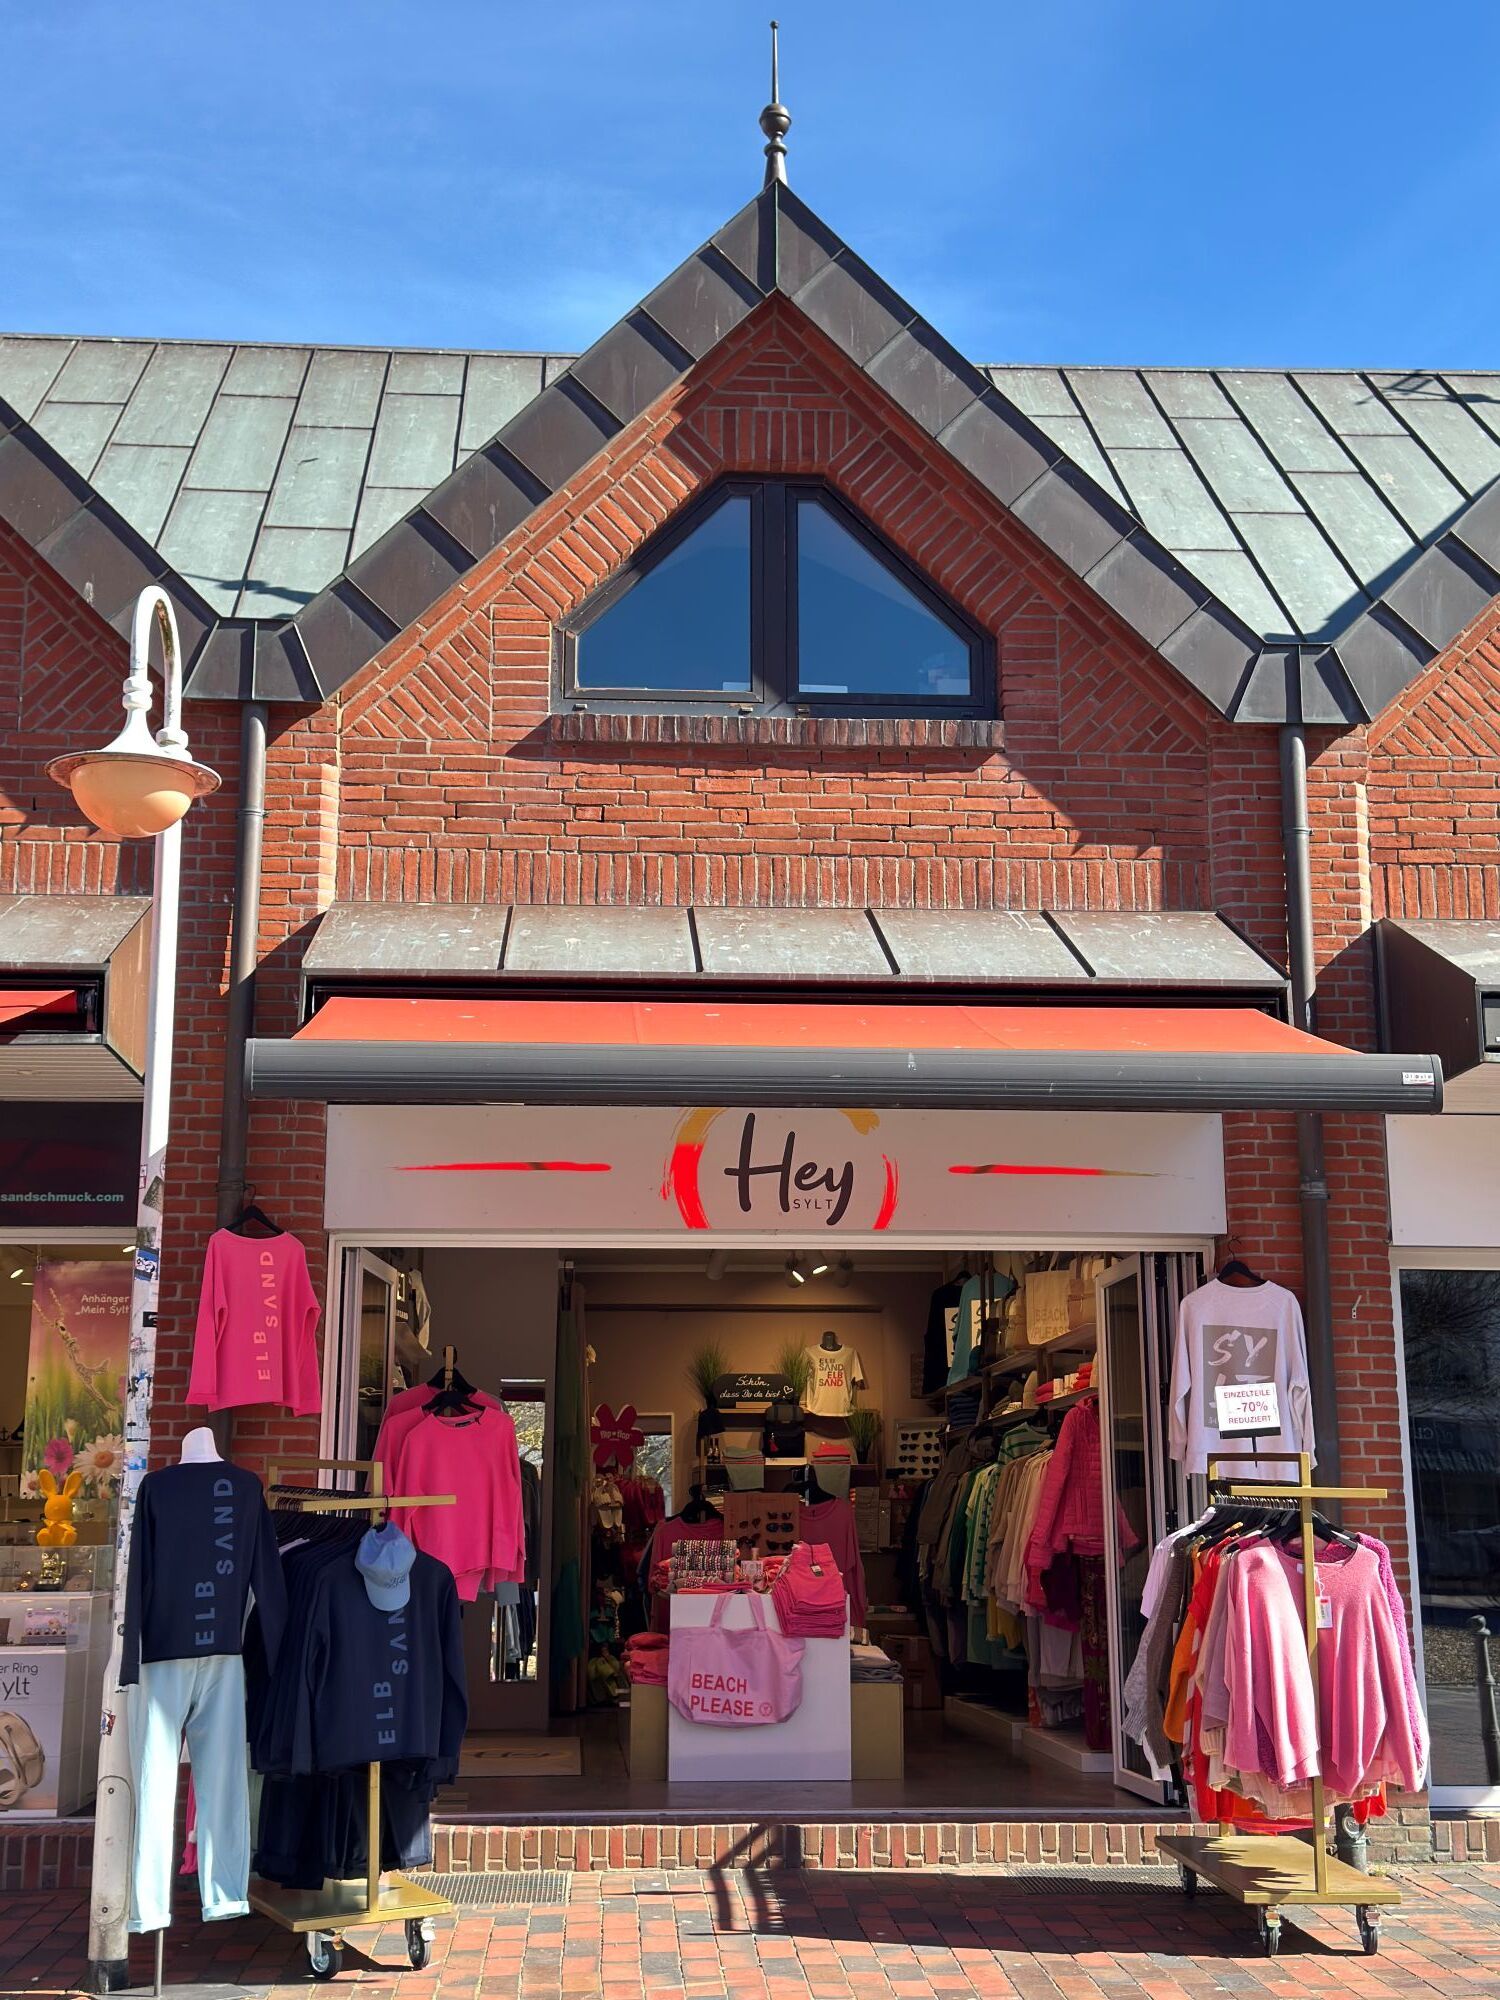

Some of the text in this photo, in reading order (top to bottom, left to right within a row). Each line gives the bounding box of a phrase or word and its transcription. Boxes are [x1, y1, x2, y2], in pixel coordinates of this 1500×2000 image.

[724, 1112, 854, 1226] Hey
[0, 1192, 124, 1202] sandschmuck.com
[793, 1199, 833, 1210] SYLT
[81, 1293, 130, 1306] Anhänger
[253, 1251, 279, 1380] ELB SAND
[819, 1363, 844, 1371] SAND
[827, 1371, 843, 1379] ELB
[819, 1378, 844, 1387] SAND
[1223, 1389, 1271, 1399] EINZELTEILE
[1236, 1401, 1269, 1413] -70%
[1228, 1415, 1272, 1425] REDUZIERT
[195, 1478, 234, 1646] ELB SAND
[12, 1662, 38, 1676] Ring
[373, 1681, 396, 1745] ELB
[388, 1609, 409, 1675] SAN
[691, 1673, 747, 1694] BEACH
[690, 1695, 754, 1717] PLEASE
